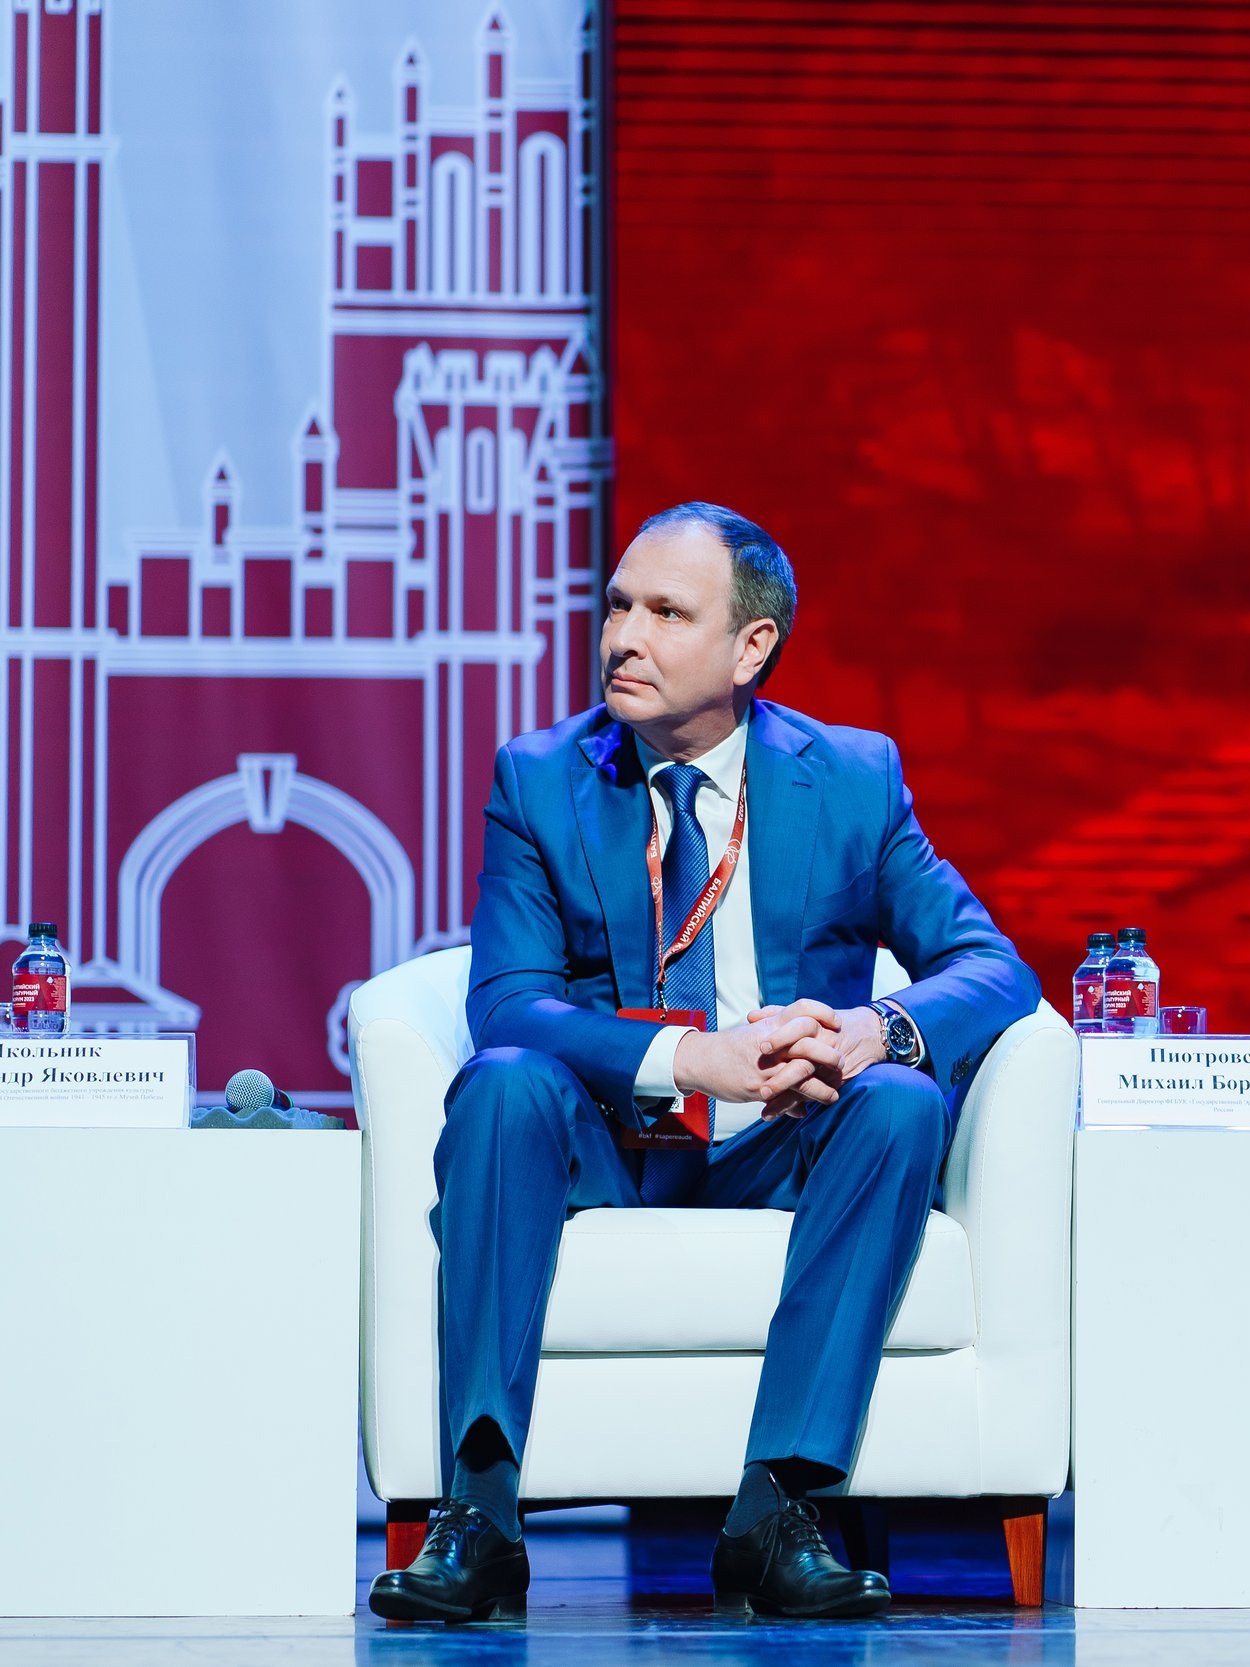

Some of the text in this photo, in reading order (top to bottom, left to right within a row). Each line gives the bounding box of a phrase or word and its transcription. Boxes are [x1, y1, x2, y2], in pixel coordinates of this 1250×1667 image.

[680, 877, 722, 943] БАЛТИЙСКИЙ
[42, 1067, 165, 1083] Яковлевич
[1118, 1073, 1204, 1090] Михаил
